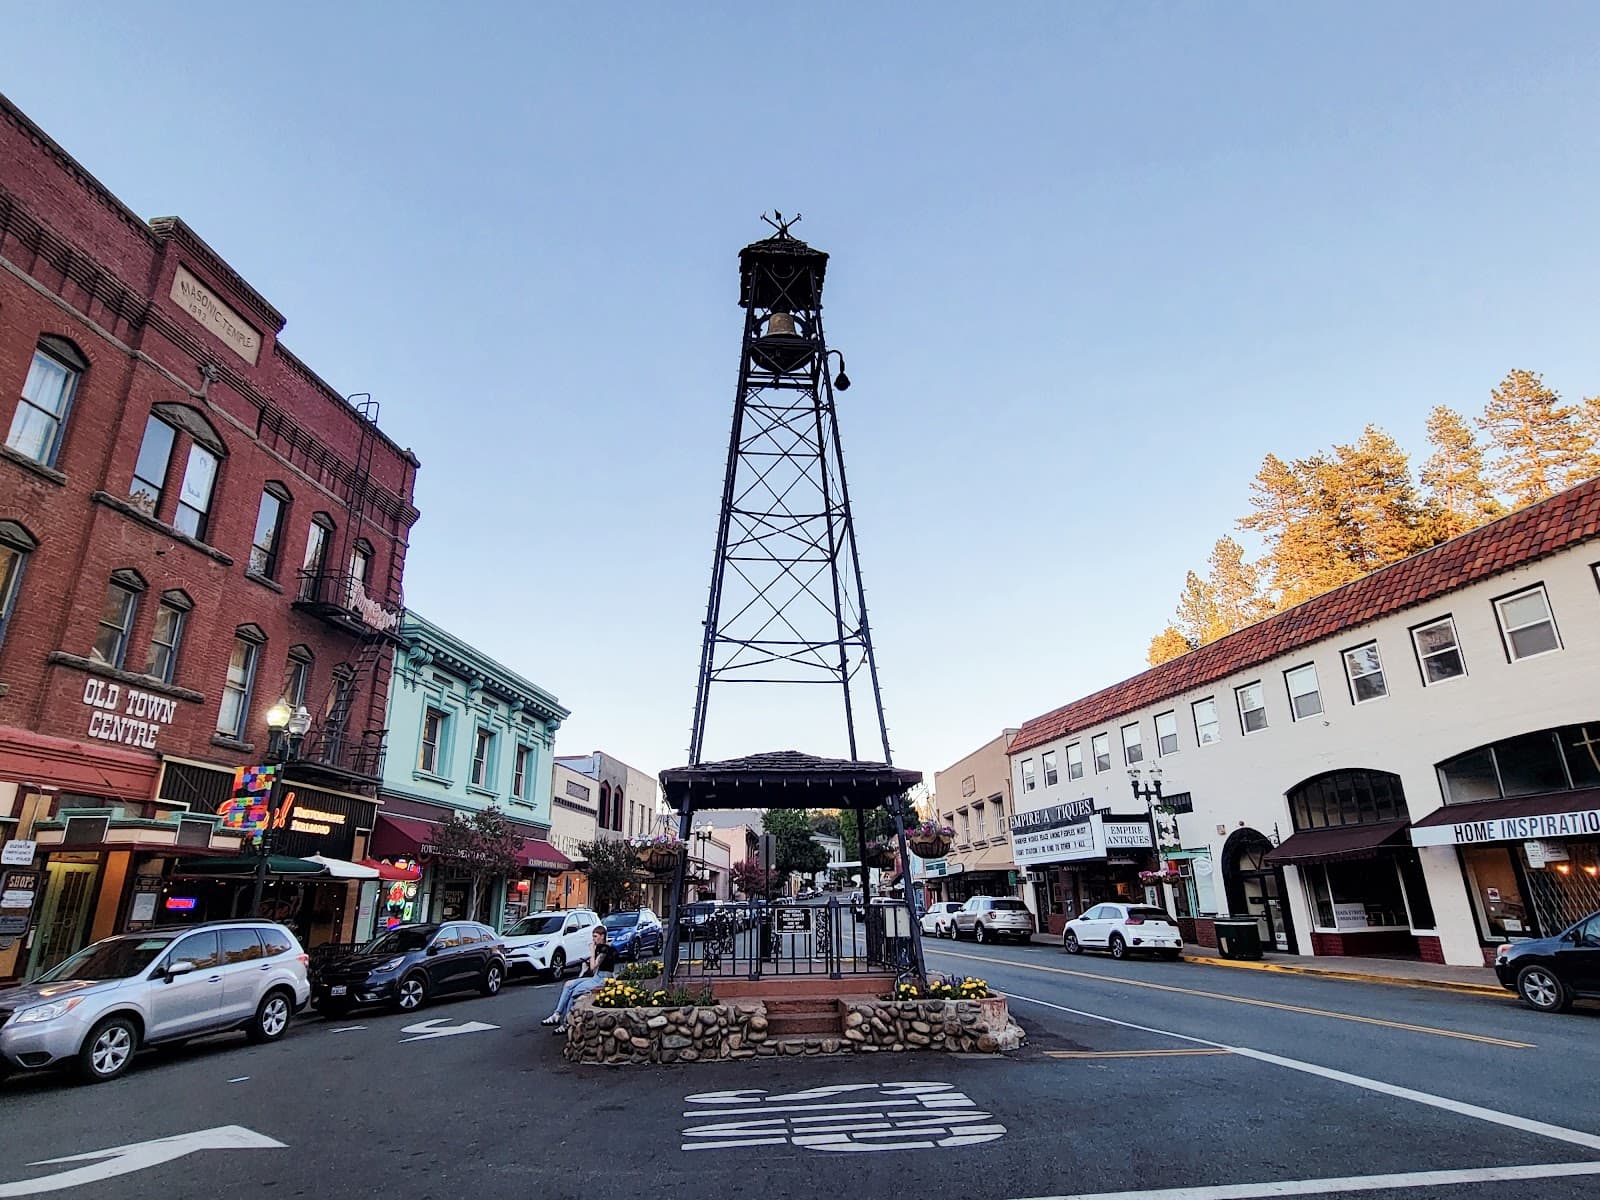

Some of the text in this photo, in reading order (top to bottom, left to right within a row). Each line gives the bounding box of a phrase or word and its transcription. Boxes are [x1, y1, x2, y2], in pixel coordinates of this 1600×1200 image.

[180, 280, 254, 349] MASONIC TEMPLE
[83, 678, 177, 724] OLD TOWN
[88, 710, 160, 749] CENTRE
[1009, 810, 1041, 829] EMPIRE
[1110, 826, 1143, 835] EMPIRE
[1454, 811, 1600, 843] HOME INSPIRATIO
[1107, 835, 1150, 846] ANTIQUES
[8, 875, 35, 889] SHOPS
